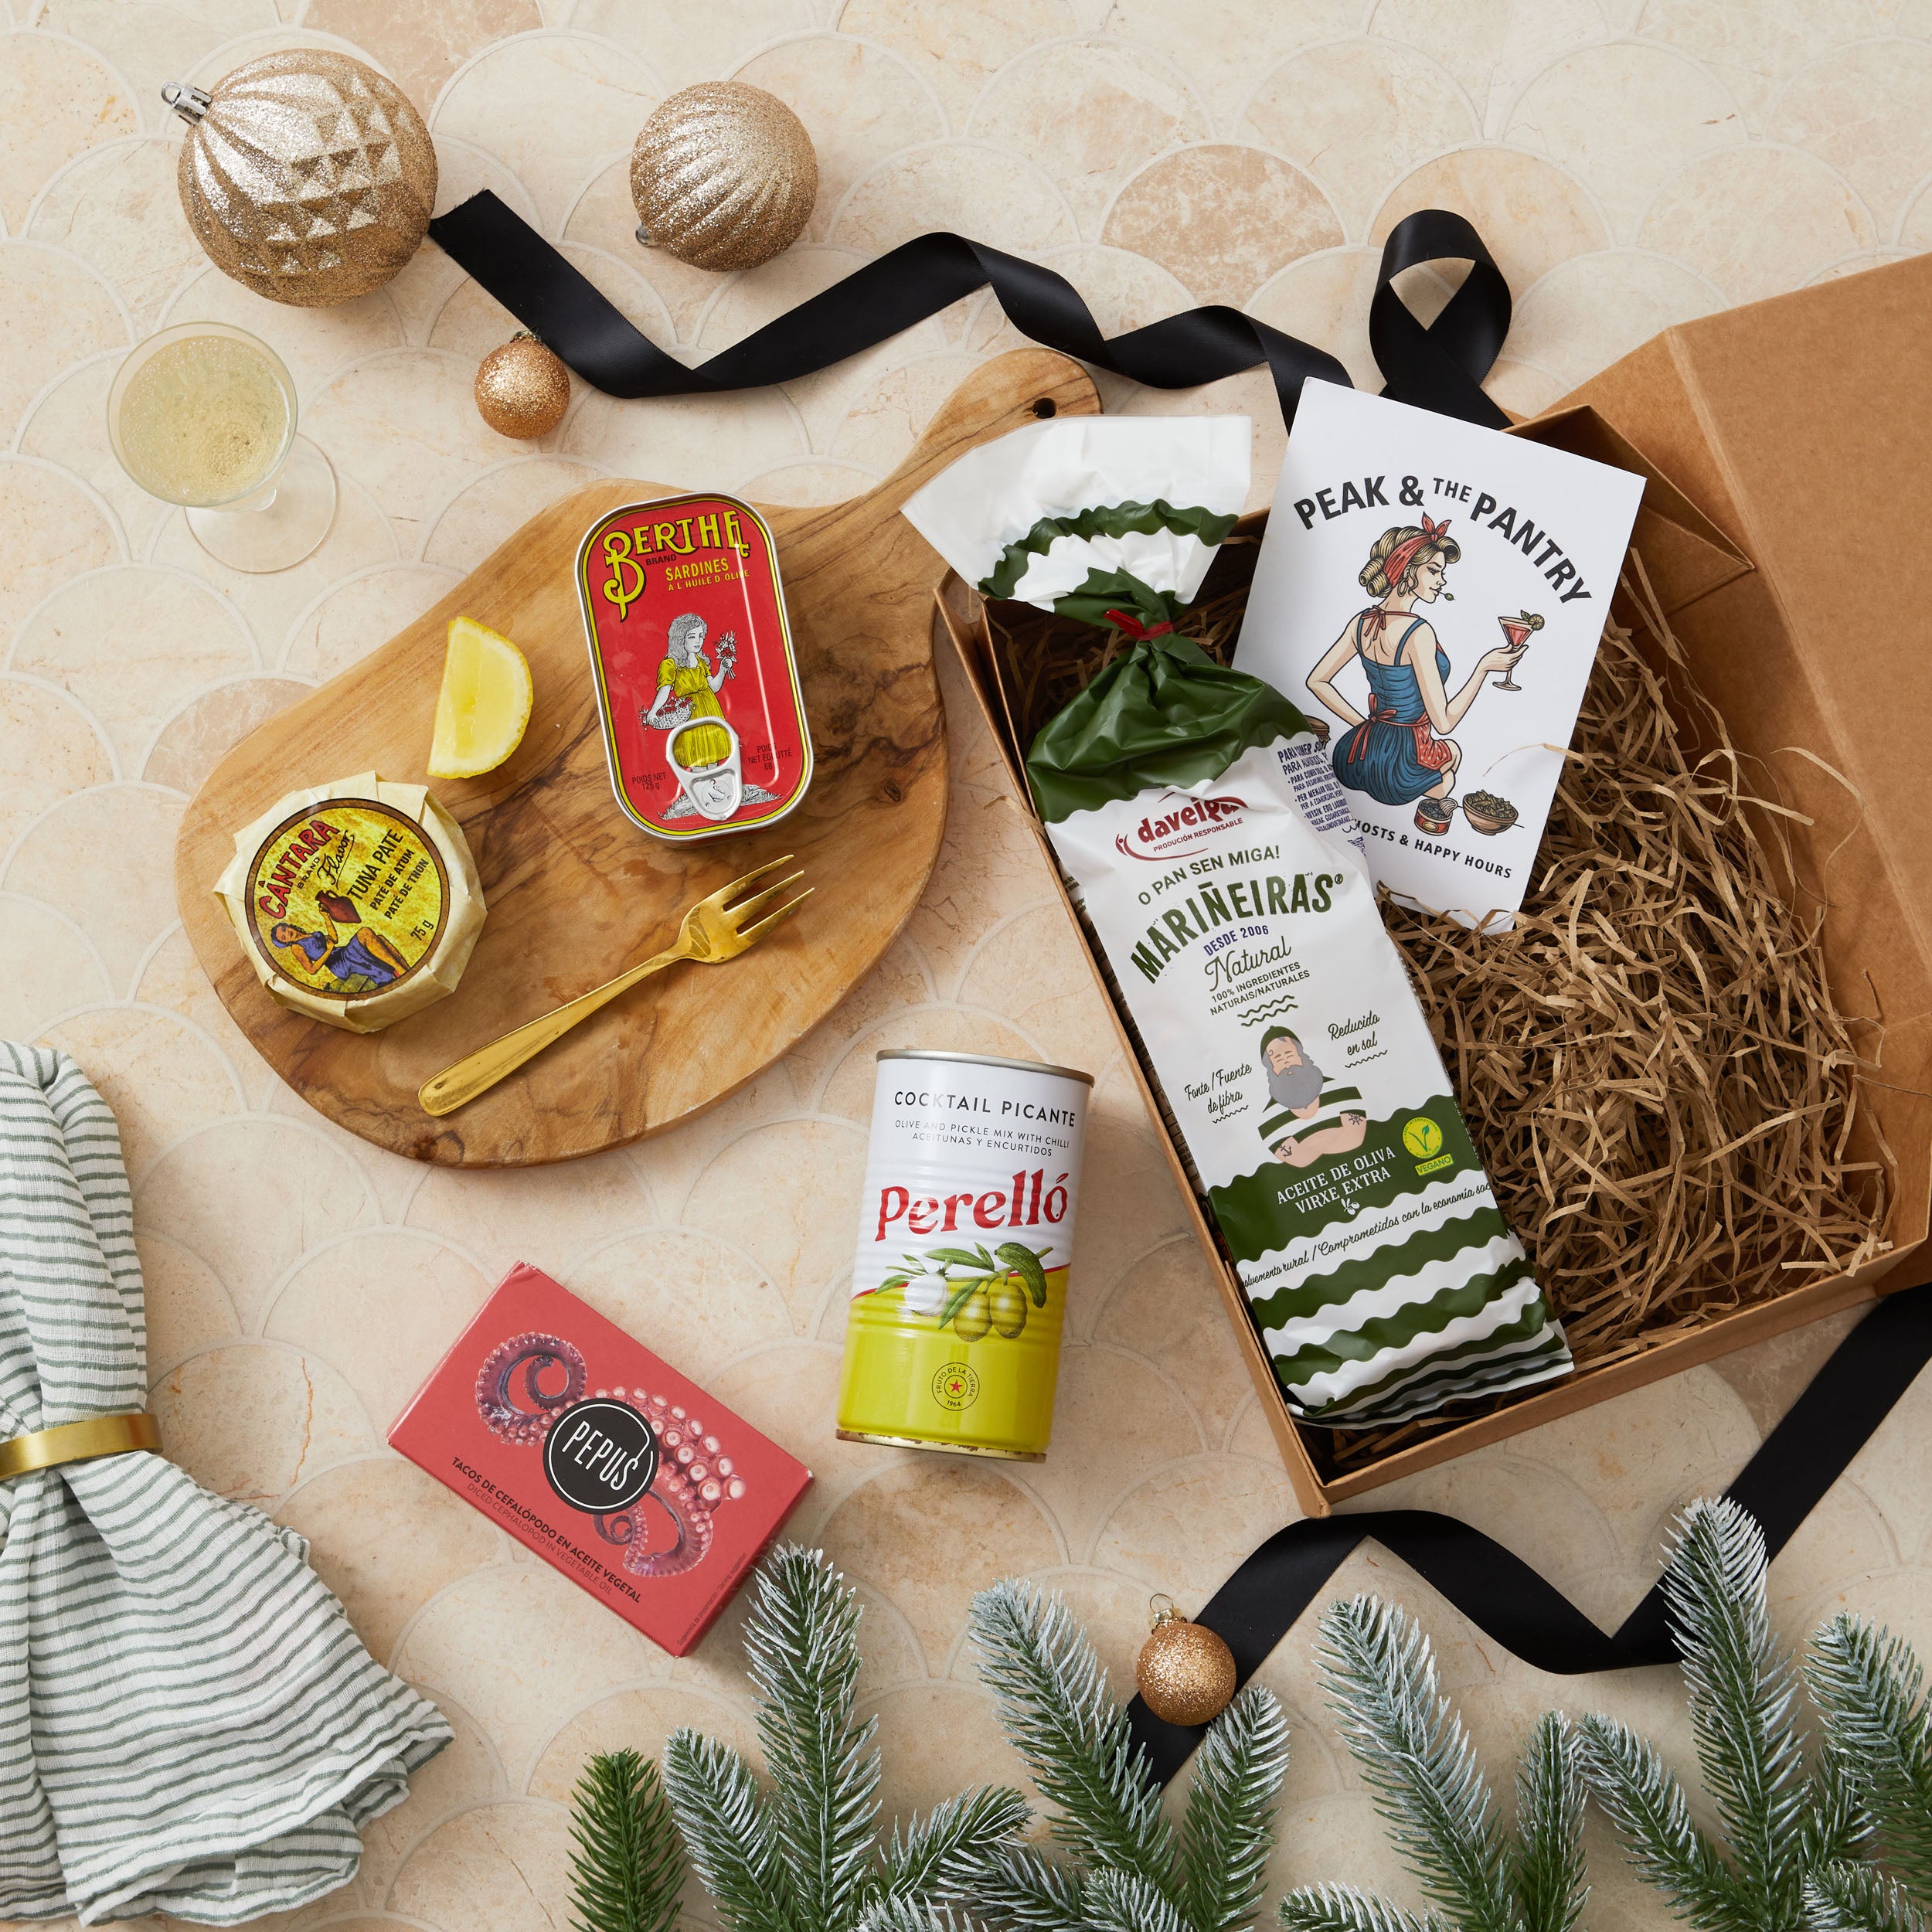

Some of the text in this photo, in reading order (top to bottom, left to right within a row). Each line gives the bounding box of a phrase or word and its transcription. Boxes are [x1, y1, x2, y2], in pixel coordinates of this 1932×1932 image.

[1294, 475, 1592, 604] PEAK & THE PANTRY
[603, 510, 751, 623] BERTHE
[645, 553, 677, 566] BRAND
[665, 557, 730, 582] SARDINES
[748, 755, 760, 764] NET
[1277, 747, 1298, 763] PARA
[1283, 761, 1302, 775] PARA
[632, 772, 666, 784] POIDS NET
[1294, 783, 1306, 792] PARA
[1301, 802, 1310, 811] PER
[1153, 817, 1243, 852] PRODUCIÓN RESPONSABLE
[1358, 821, 1512, 879] OSTS & HAPPY HOURS
[258, 820, 341, 920] CÂNTARA
[297, 857, 320, 889] BRAND
[317, 830, 355, 890] Flavor
[346, 828, 403, 900] TUNA PATE
[1138, 845, 1281, 906] O PAN SEN MIGA!
[369, 849, 415, 910] PATÉ DE ATUM
[384, 858, 429, 920] PATÉ DE THON
[410, 920, 434, 941] 75 g
[1202, 925, 1269, 957] DESDE 2006
[1204, 935, 1292, 992] Natural
[1212, 961, 1301, 1003] 100% INGREDIENTES
[1209, 970, 1311, 1016] NATURAIS/NATURALES
[1328, 1010, 1380, 1041] Reducido
[1347, 1030, 1378, 1056] en sal
[1184, 1082, 1210, 1101] Fonte
[1216, 1063, 1253, 1087] Fuente
[894, 1091, 1077, 1128] COCKTAIL PICANTE
[1207, 1090, 1243, 1114] de fibra
[895, 1120, 1070, 1149] OLIVE AND PICKLE MIX WITH CHILLI
[912, 1133, 1053, 1157] ACEITUNAS Y ENCURTIDOS
[1277, 1146, 1396, 1205] ACEITE DE OLIVA
[1417, 1155, 1451, 1174] VEGANO
[875, 1168, 1070, 1242] Perelló
[1294, 1165, 1391, 1214] VIRXE EXTRA
[1282, 1250, 1310, 1272] rural
[1318, 1216, 1400, 1256] Comprometidos
[1402, 1209, 1420, 1223] con
[1421, 1201, 1433, 1215] la
[1433, 1188, 1475, 1210] economía
[936, 1371, 947, 1394] FRUTO
[957, 1367, 966, 1376] LA
[966, 1373, 976, 1396] TIERRA
[562, 1420, 638, 1491] PEPUS
[451, 1457, 642, 1604] TACOS DE CEFALÓPODO EN ACEITE VEGETAL
[467, 1482, 611, 1596] DICED CEPHALOPOD IN VEGETABLE OIL
